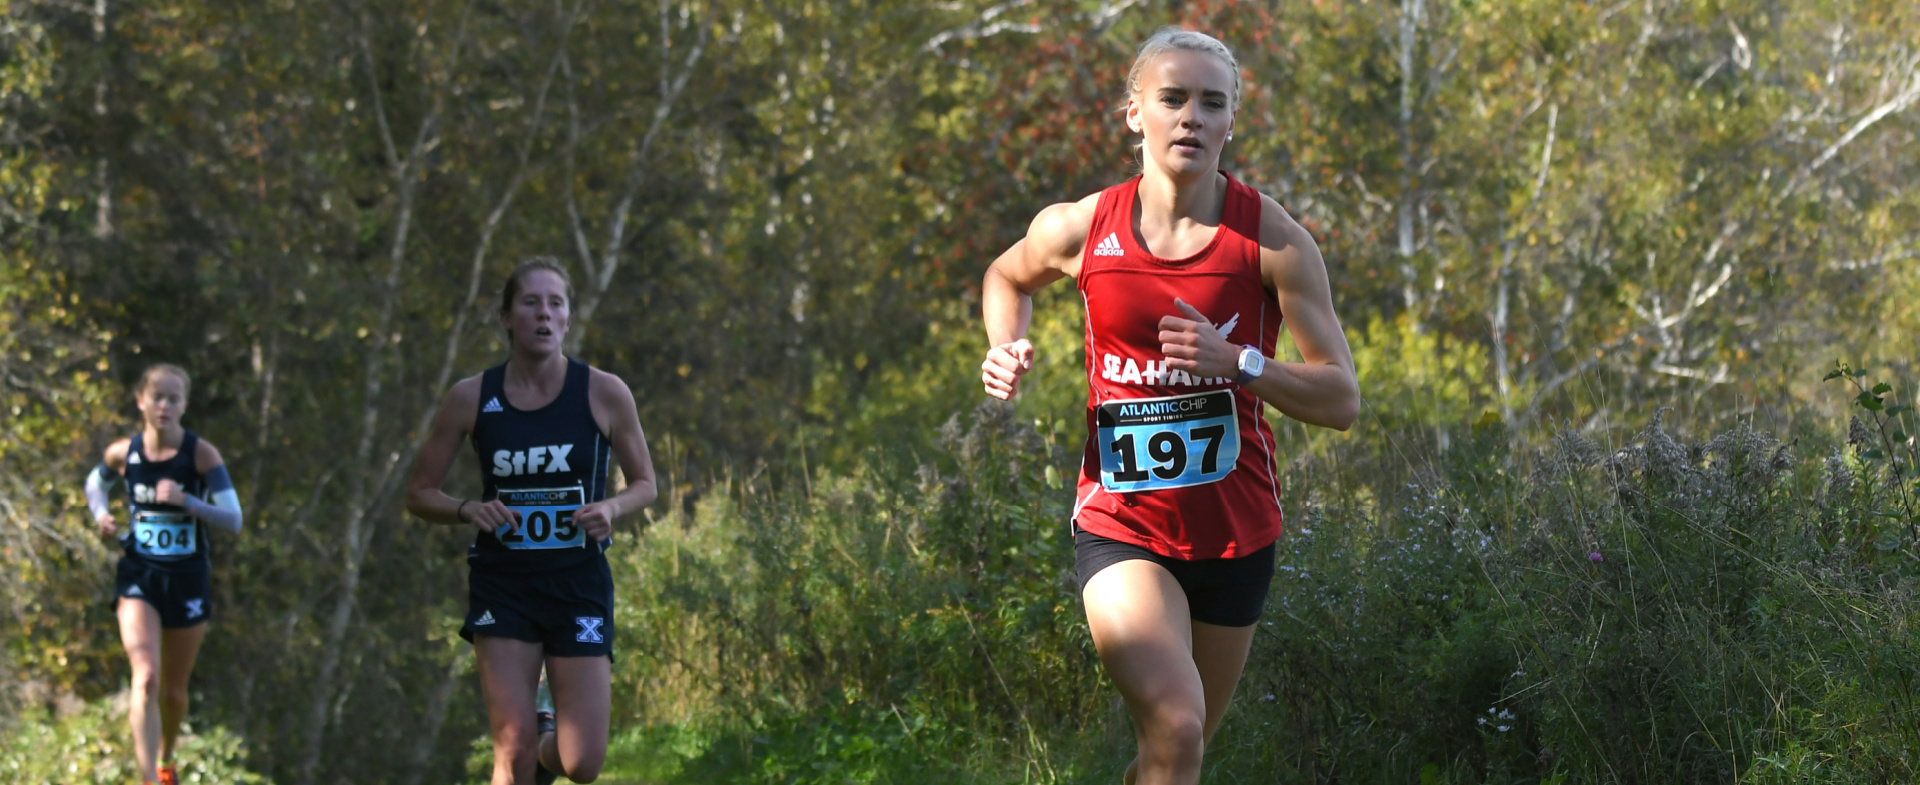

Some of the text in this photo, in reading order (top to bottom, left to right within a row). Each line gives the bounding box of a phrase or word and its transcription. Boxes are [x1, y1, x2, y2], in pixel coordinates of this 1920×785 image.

[1093, 246, 1125, 257] adidas
[493, 444, 574, 477] StFX
[1110, 424, 1225, 482] 197
[141, 528, 190, 549] 204
[502, 510, 578, 543] 205
